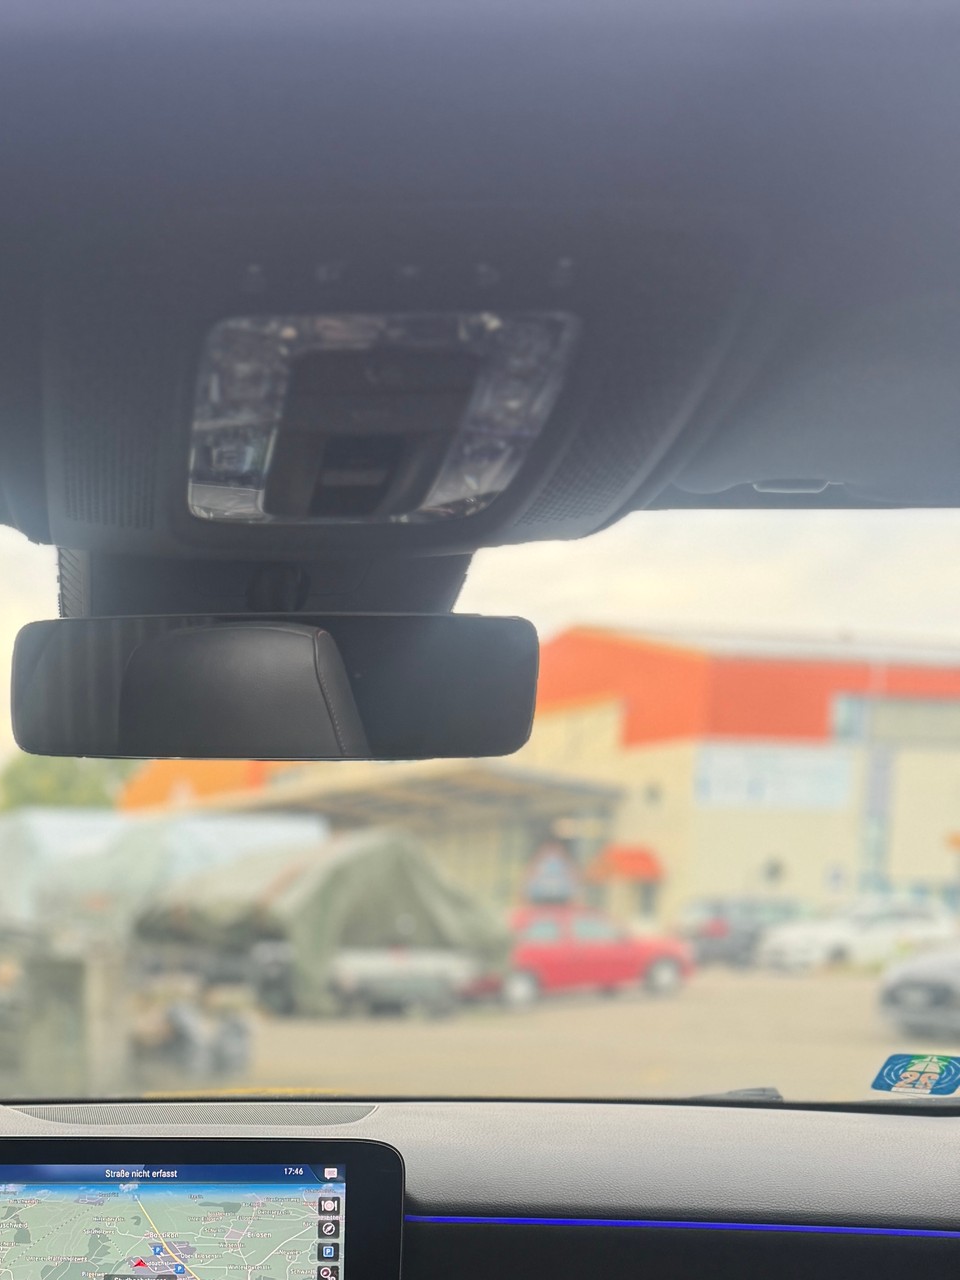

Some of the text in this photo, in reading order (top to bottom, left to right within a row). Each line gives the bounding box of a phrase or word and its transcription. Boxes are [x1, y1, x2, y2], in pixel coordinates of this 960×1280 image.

[105, 1169, 178, 1178] Straße nicht erfasst
